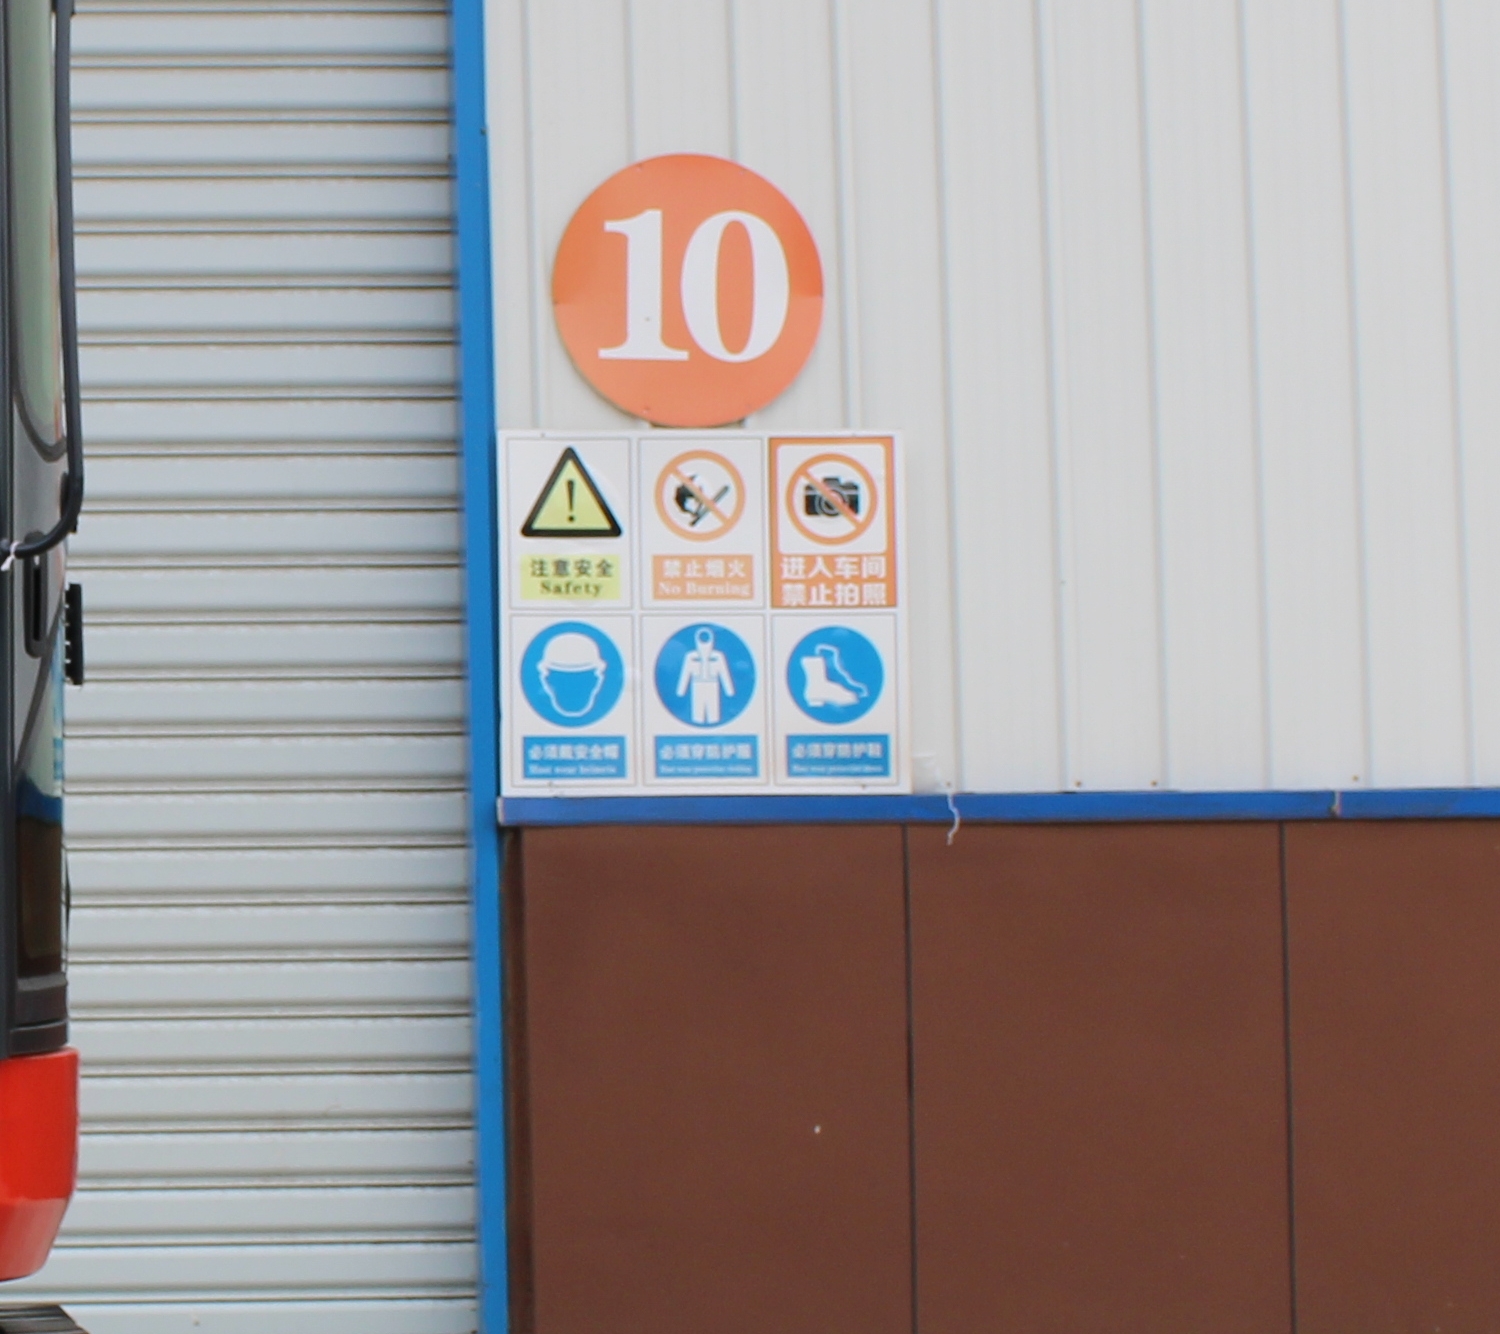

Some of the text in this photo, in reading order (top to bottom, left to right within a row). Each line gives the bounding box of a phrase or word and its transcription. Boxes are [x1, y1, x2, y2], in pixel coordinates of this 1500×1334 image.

[598, 208, 790, 363] 10
[530, 558, 613, 577] 注意安全
[663, 559, 747, 578] 禁止烟火
[780, 556, 887, 579] 进入车间
[540, 581, 603, 597] Safety
[781, 582, 887, 606] 禁止拍照
